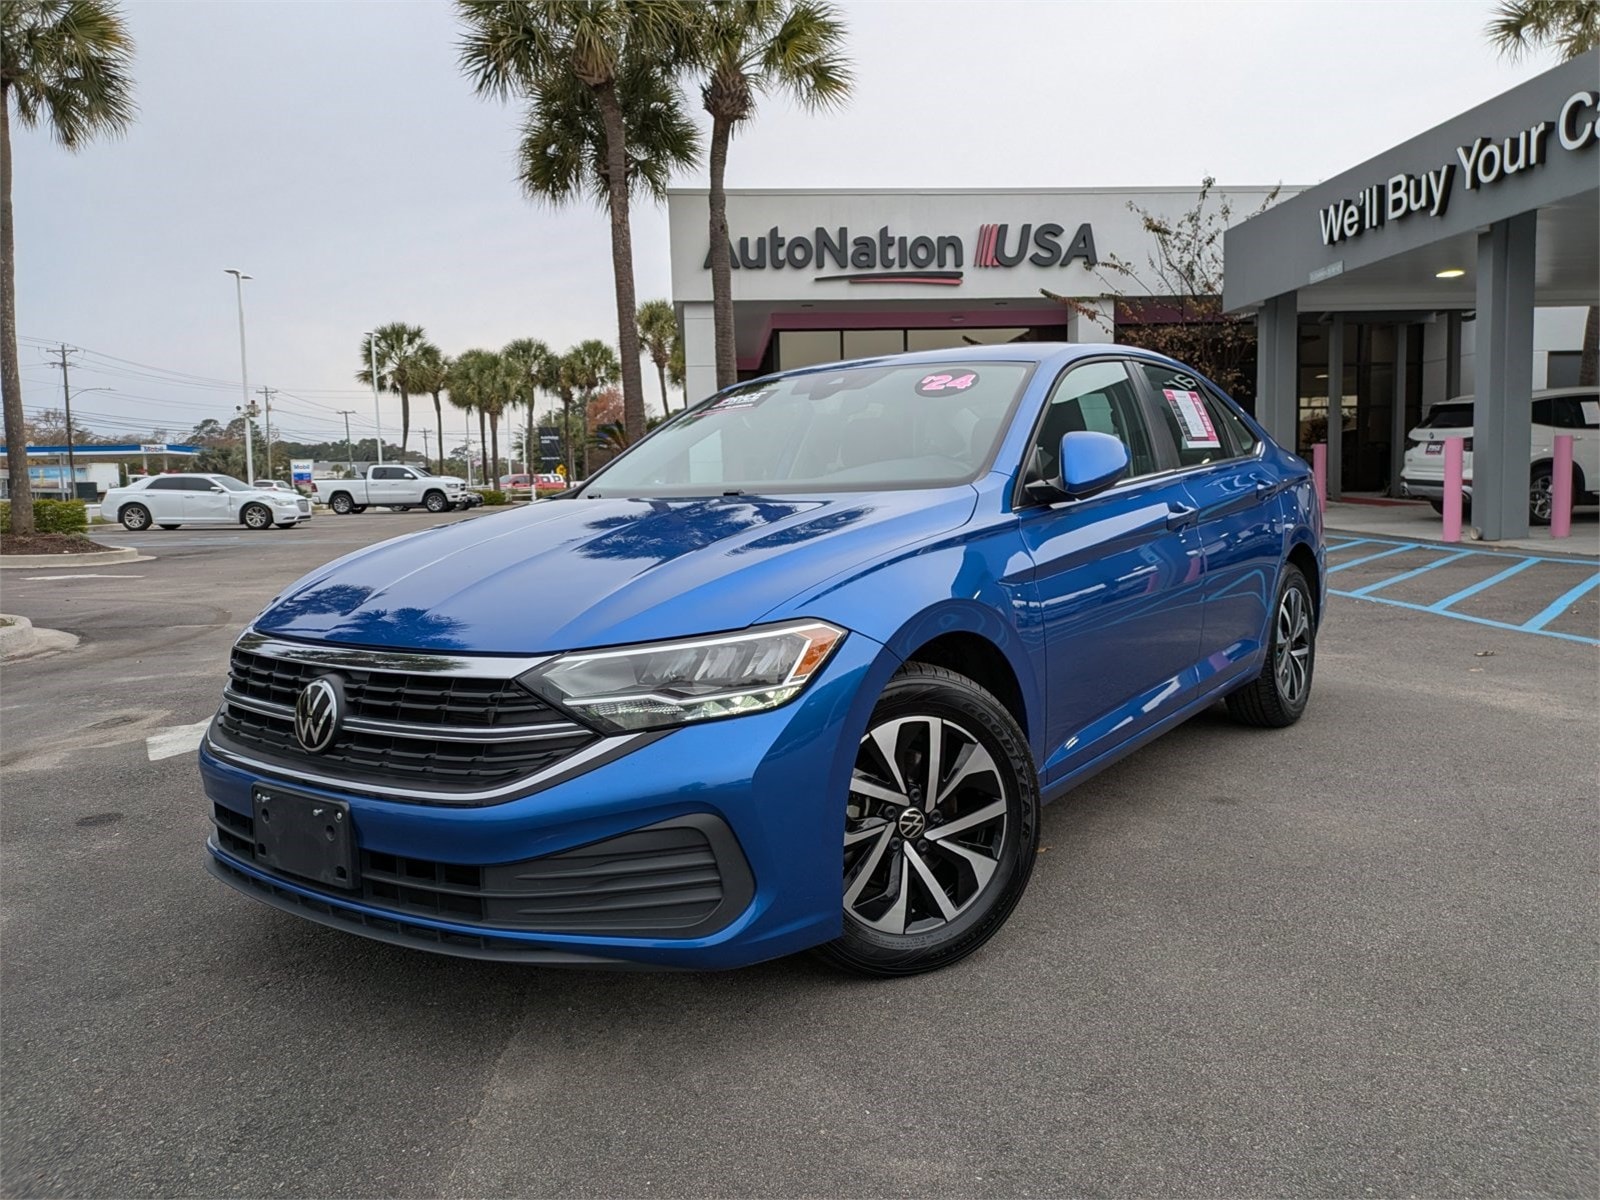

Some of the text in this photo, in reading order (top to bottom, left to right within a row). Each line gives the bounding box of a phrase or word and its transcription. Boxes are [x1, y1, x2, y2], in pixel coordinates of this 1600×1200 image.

[1319, 91, 1600, 246] We'll Buy Your C
[994, 223, 1098, 267] USA
